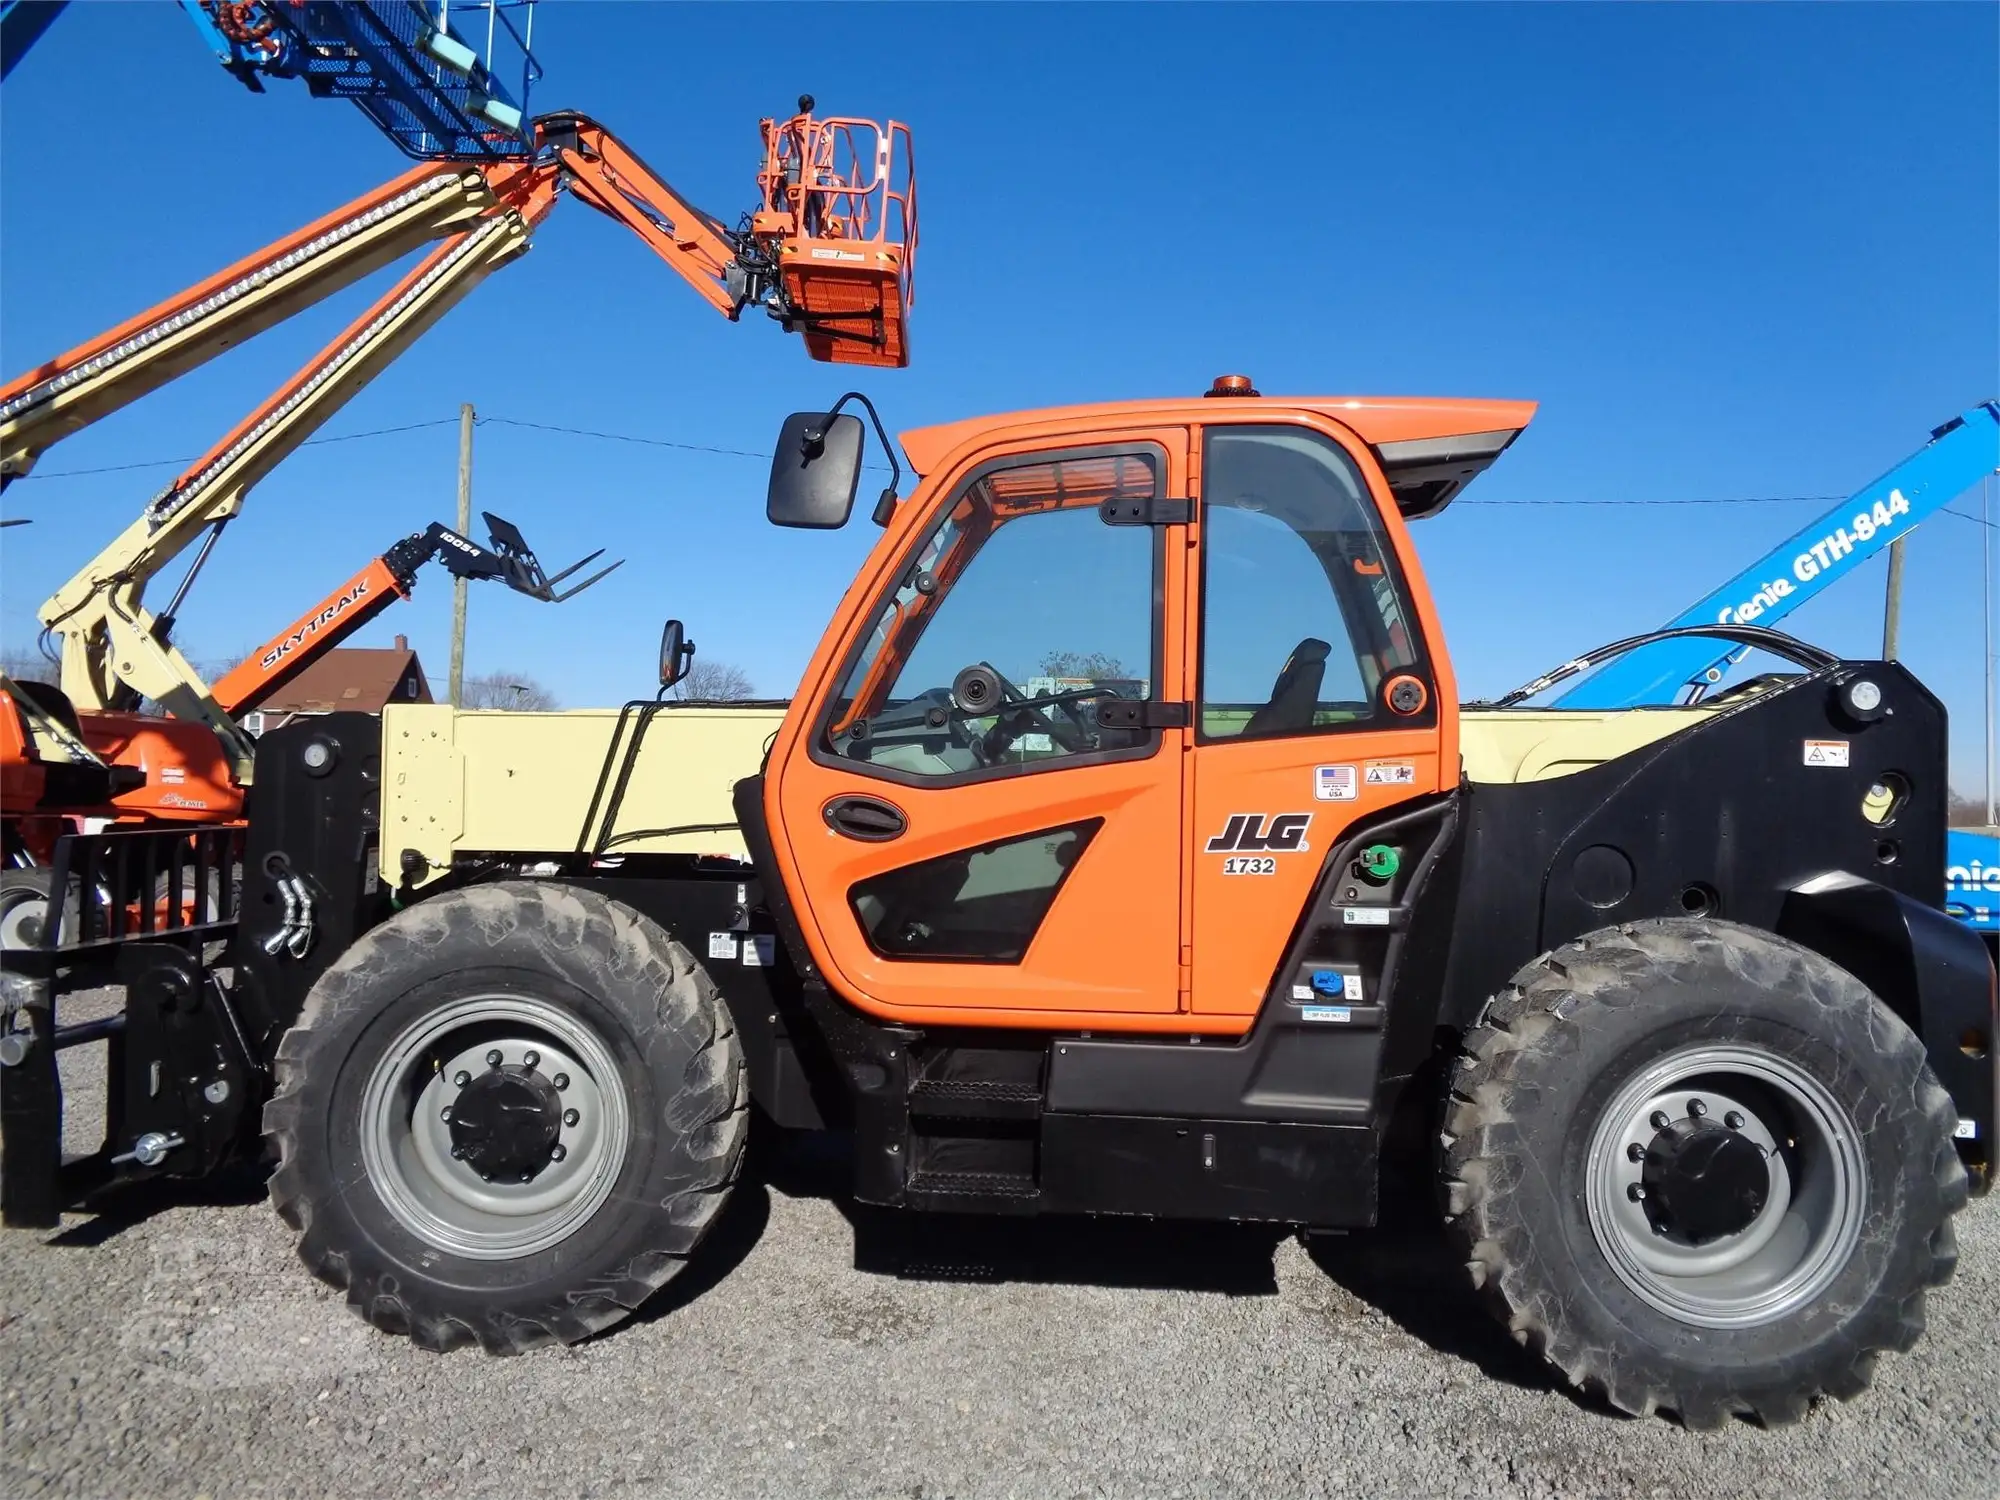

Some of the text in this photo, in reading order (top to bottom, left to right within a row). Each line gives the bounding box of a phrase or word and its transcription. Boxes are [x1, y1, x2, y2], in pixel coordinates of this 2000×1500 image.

[440, 532, 481, 557] 10054
[1793, 488, 1909, 582] GTH-844
[261, 577, 370, 670] SKYTRAK
[1205, 813, 1313, 852] JLG
[1224, 858, 1275, 875] 1732
[1946, 859, 2000, 892] nie
